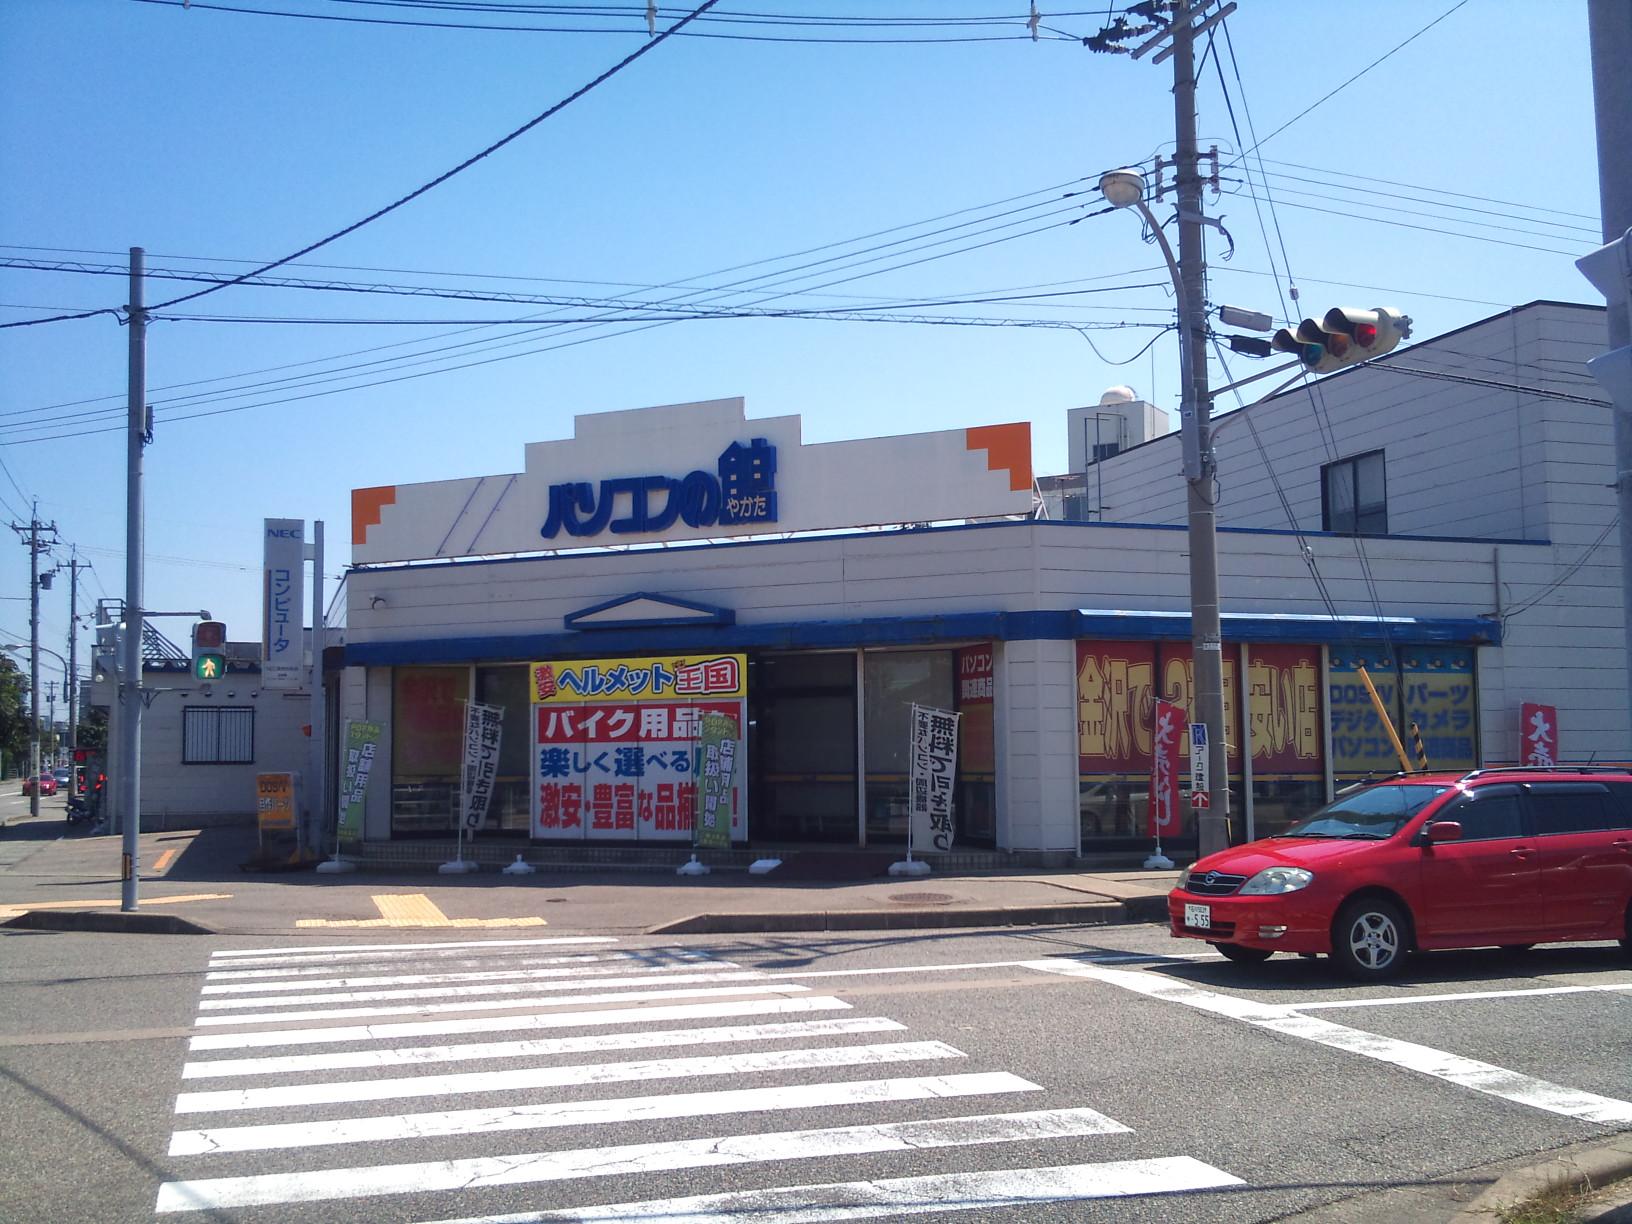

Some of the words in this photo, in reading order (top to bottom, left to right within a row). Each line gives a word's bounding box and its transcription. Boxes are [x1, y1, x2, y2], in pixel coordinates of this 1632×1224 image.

[727, 495, 766, 517] やかた
[267, 528, 301, 539] NEC
[274, 569, 291, 652] コンピュータ
[961, 653, 992, 674] パソコン
[1407, 683, 1471, 705] パーツ
